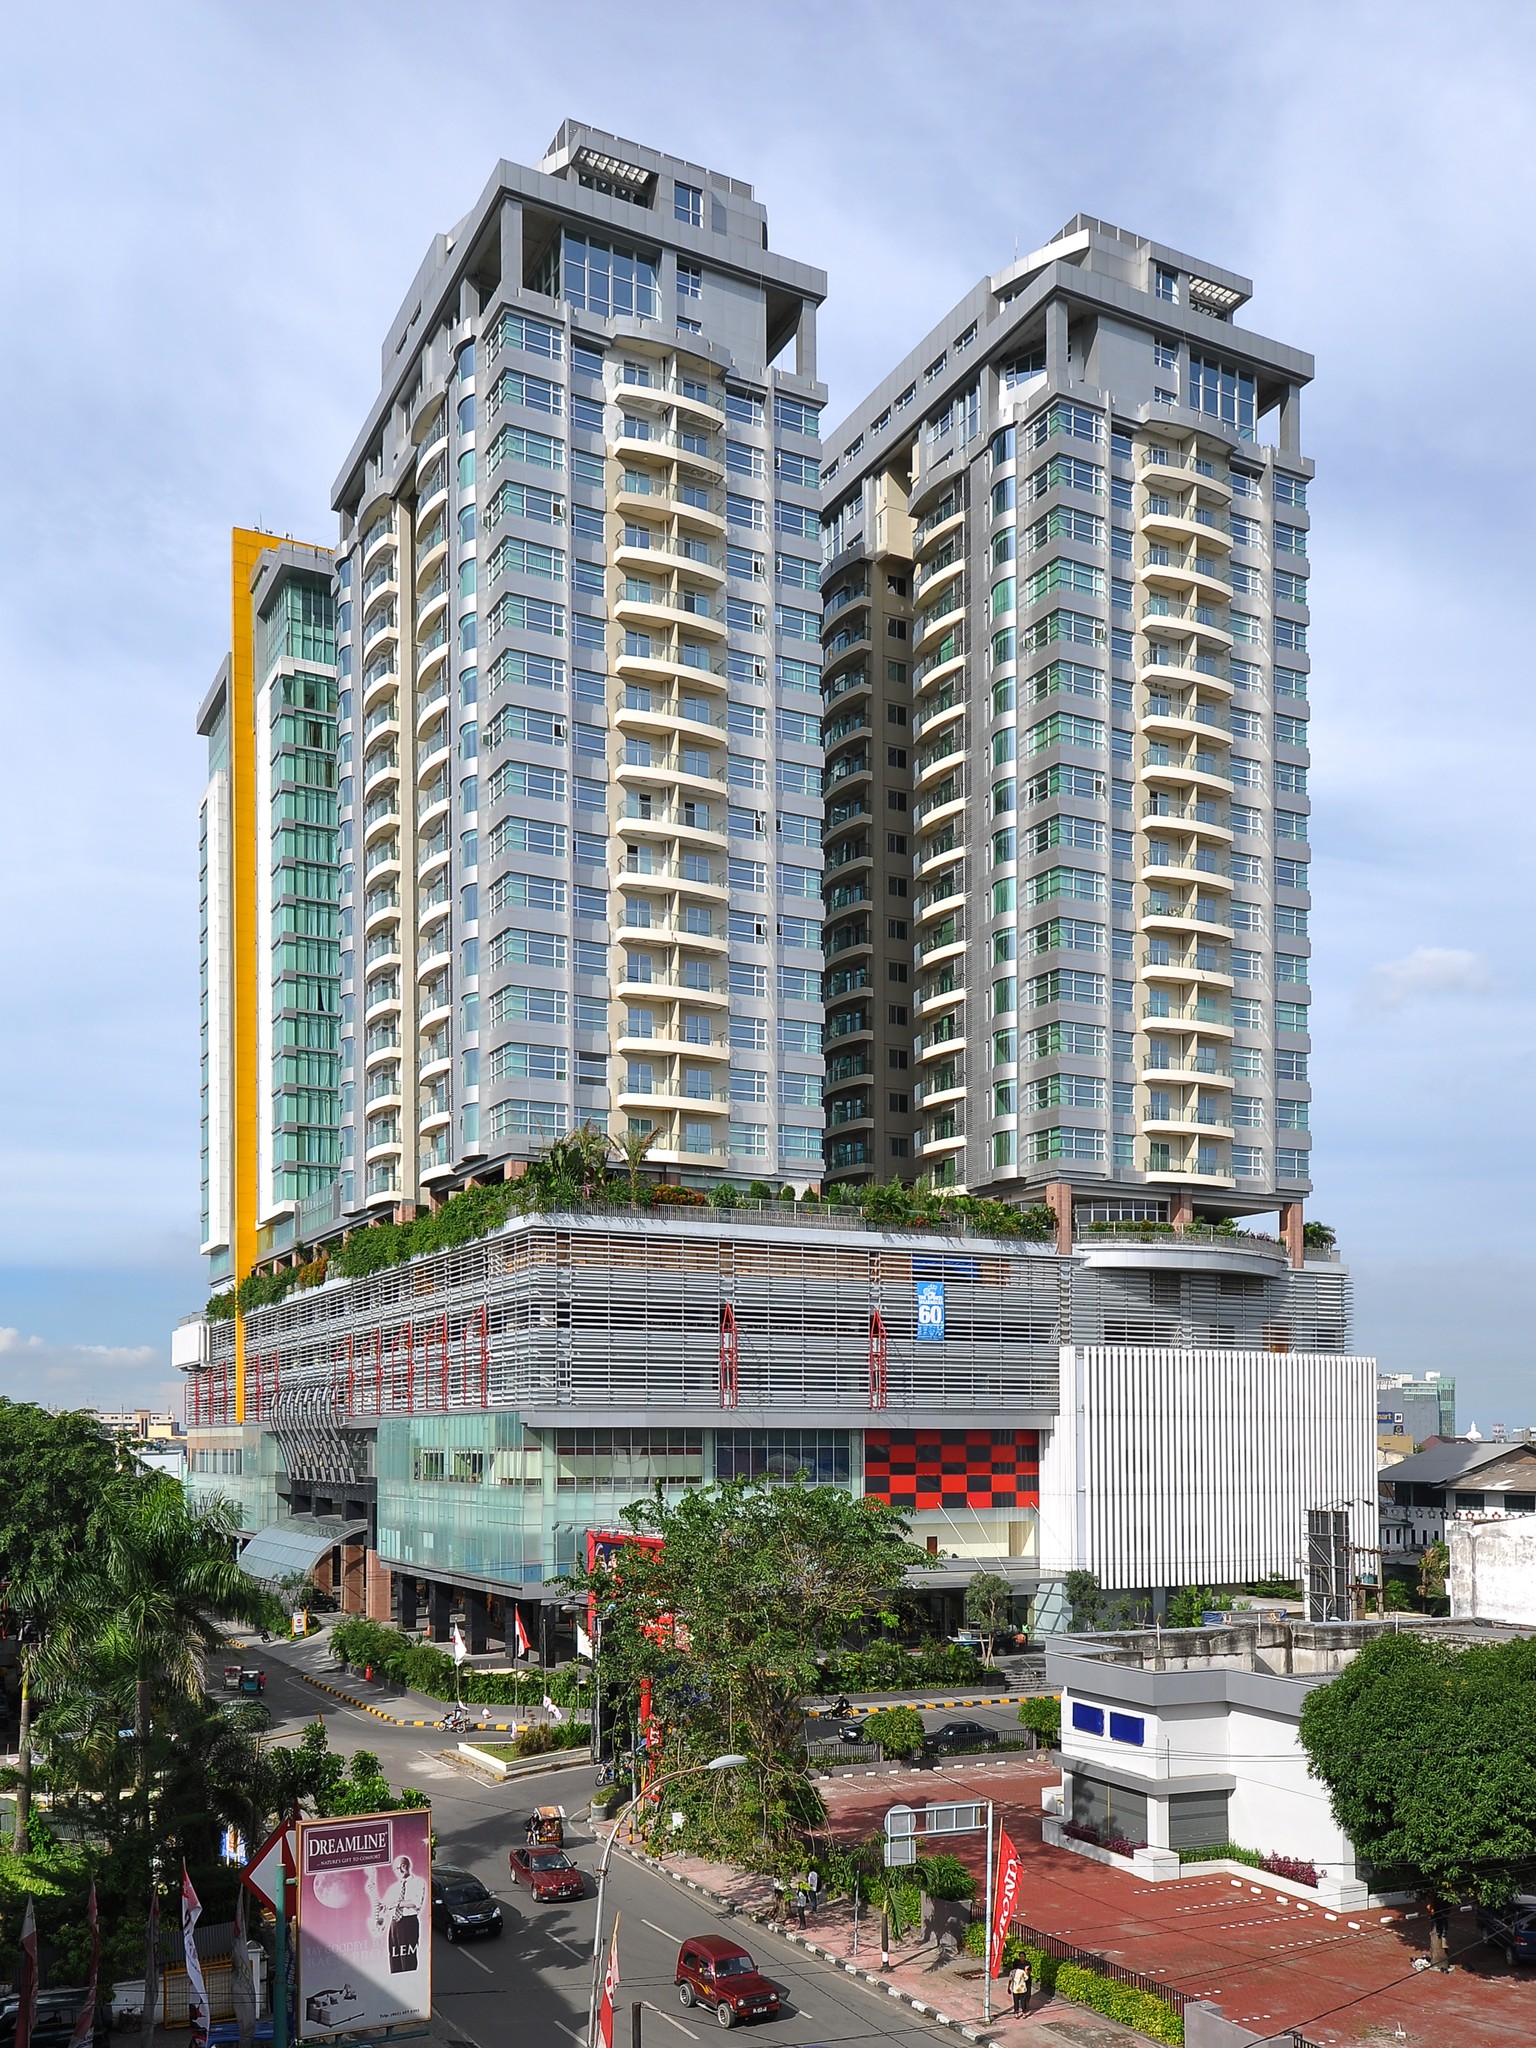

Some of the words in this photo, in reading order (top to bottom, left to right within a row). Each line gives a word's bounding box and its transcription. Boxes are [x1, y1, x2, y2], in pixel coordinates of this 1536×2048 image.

[919, 1305, 942, 1324] 60
[308, 1833, 386, 1857] DREAMLINE
[359, 1853, 382, 1862] COMFORT
[999, 1857, 1019, 1939] HOND
[324, 1939, 369, 1954] GOODBYE
[371, 1937, 385, 1948] TO
